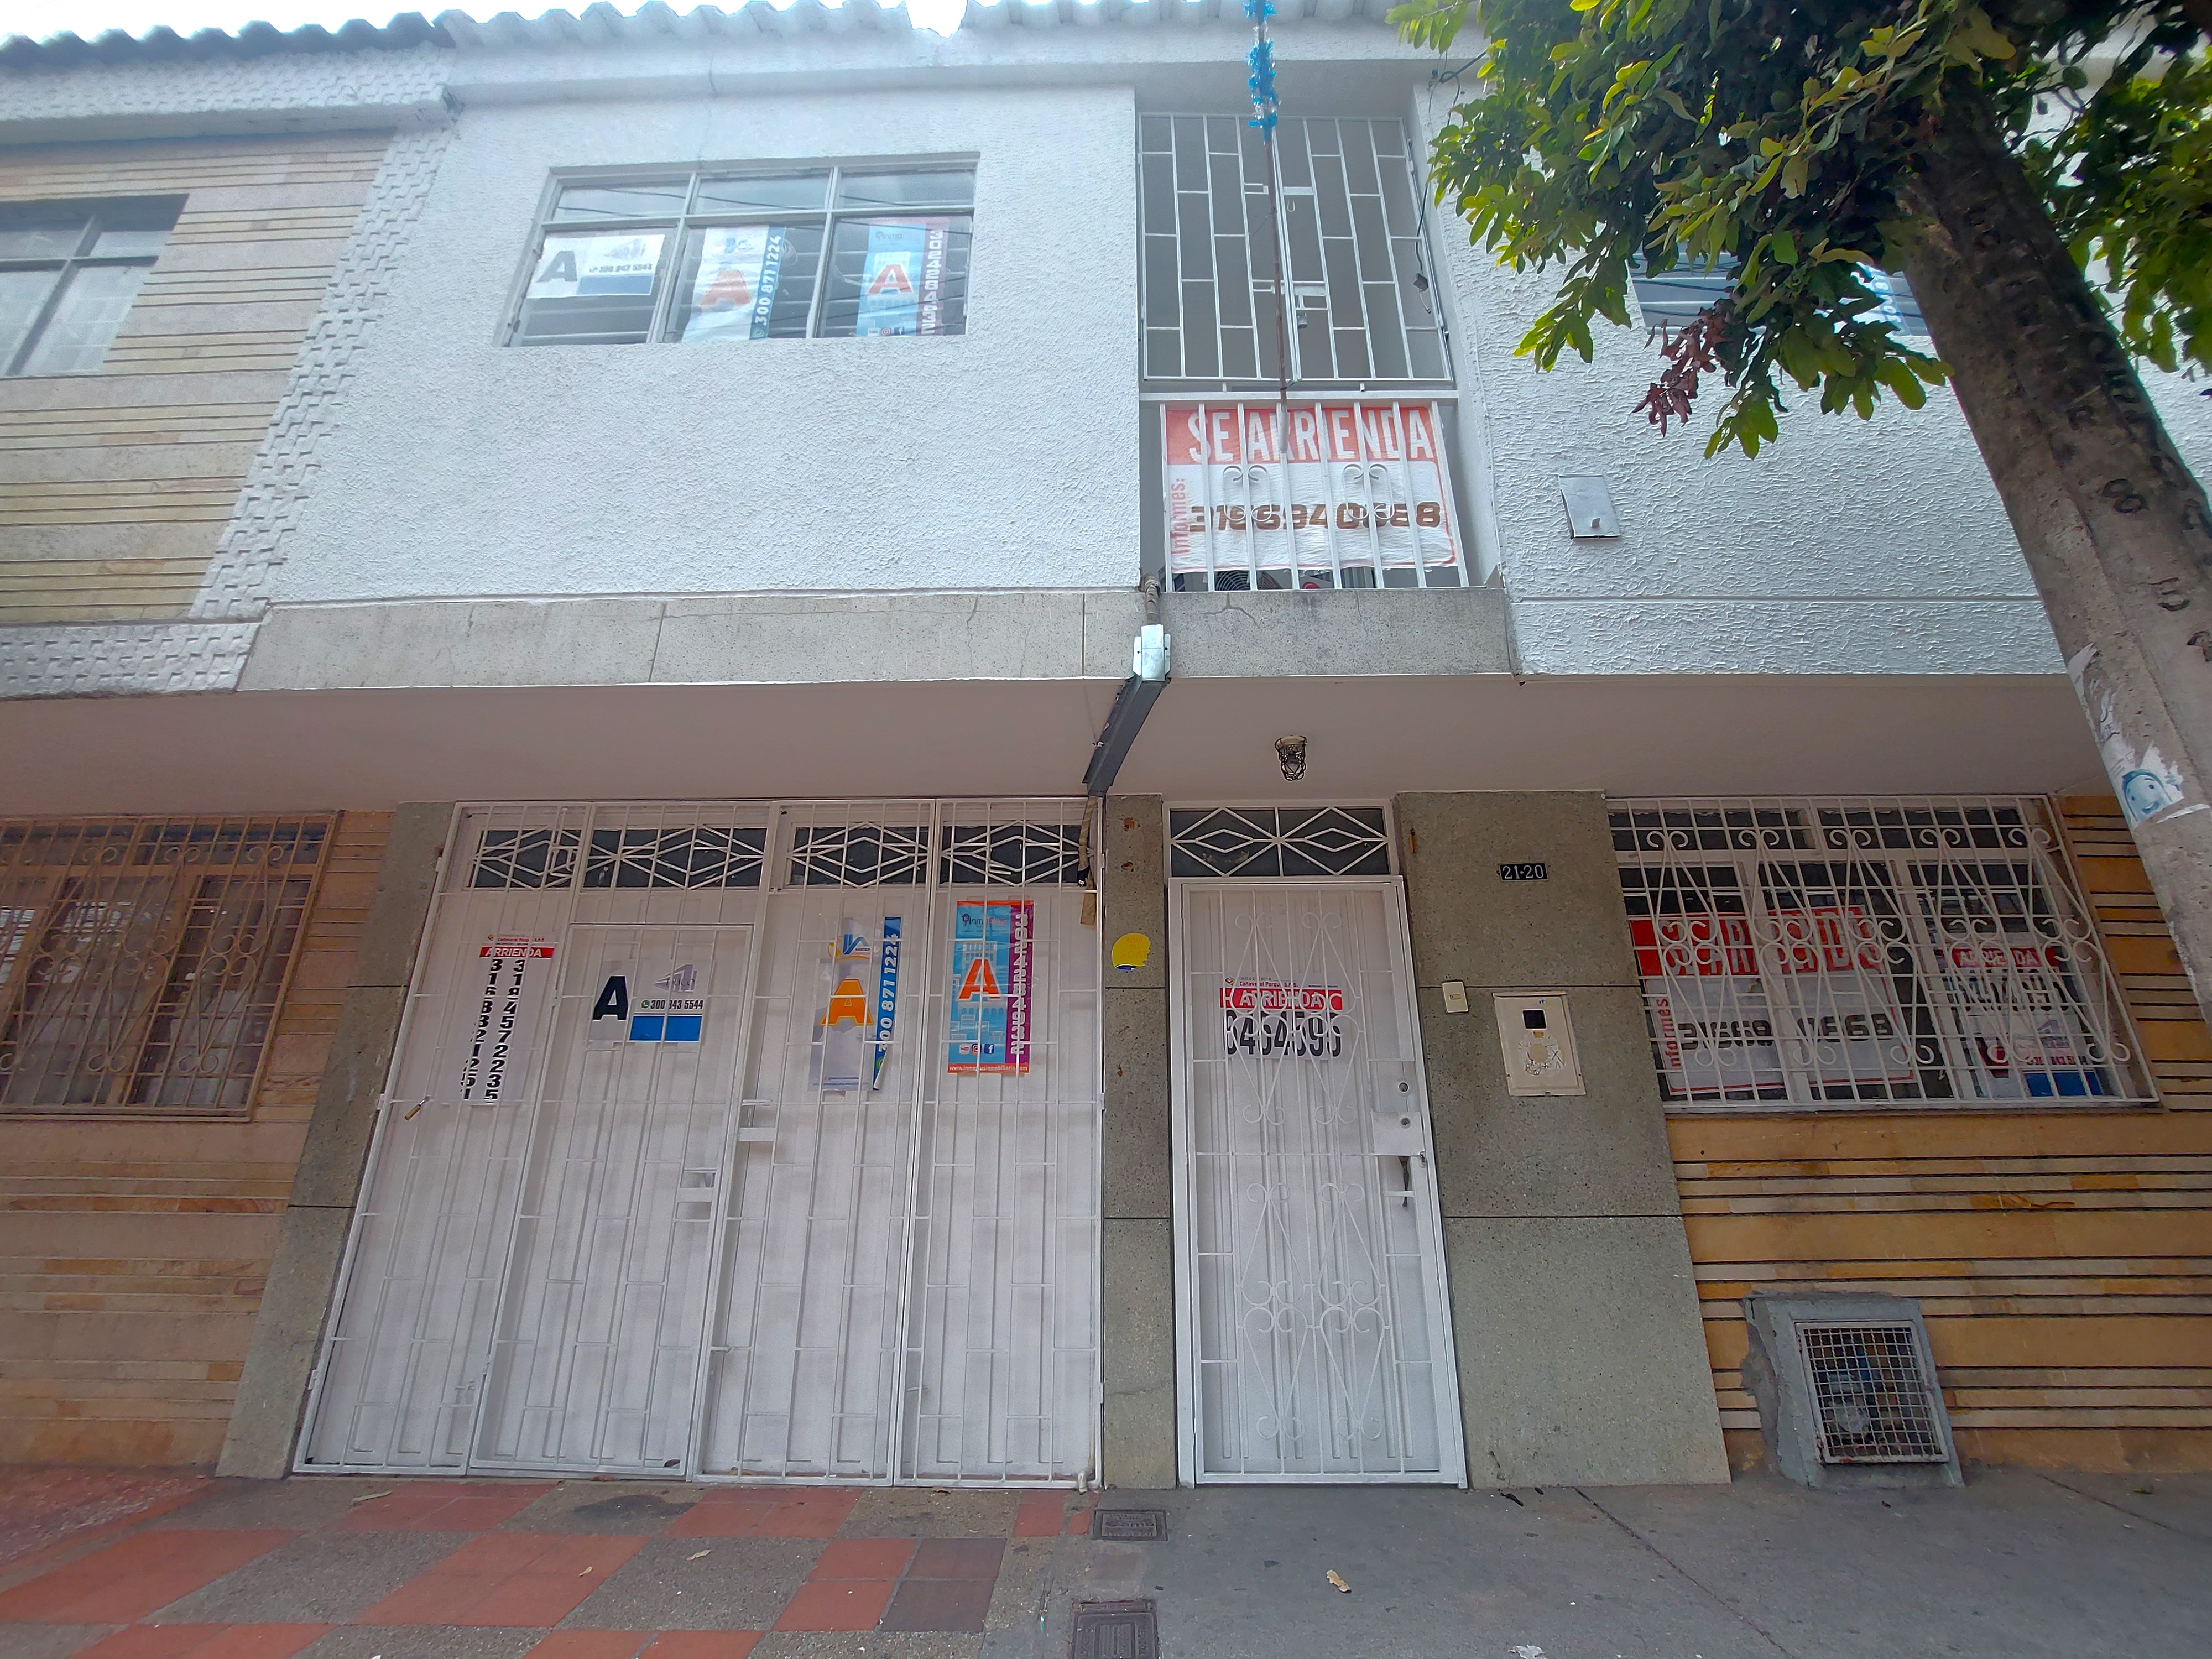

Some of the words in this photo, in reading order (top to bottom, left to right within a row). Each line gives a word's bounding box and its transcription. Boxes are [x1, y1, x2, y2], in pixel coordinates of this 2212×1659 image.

[536, 251, 577, 283] A
[766, 236, 781, 267] 1224
[761, 270, 776, 293] 871
[867, 264, 913, 294] A
[755, 297, 771, 326] 300
[1188, 411, 1234, 463] SE
[1248, 410, 1434, 461] ARRIENDA
[959, 959, 1001, 999] A
[592, 975, 629, 1021] A
[650, 1000, 666, 1009] 300
[684, 1000, 704, 1009] 5544
[820, 979, 874, 1027] A
[881, 980, 895, 1011] 871
